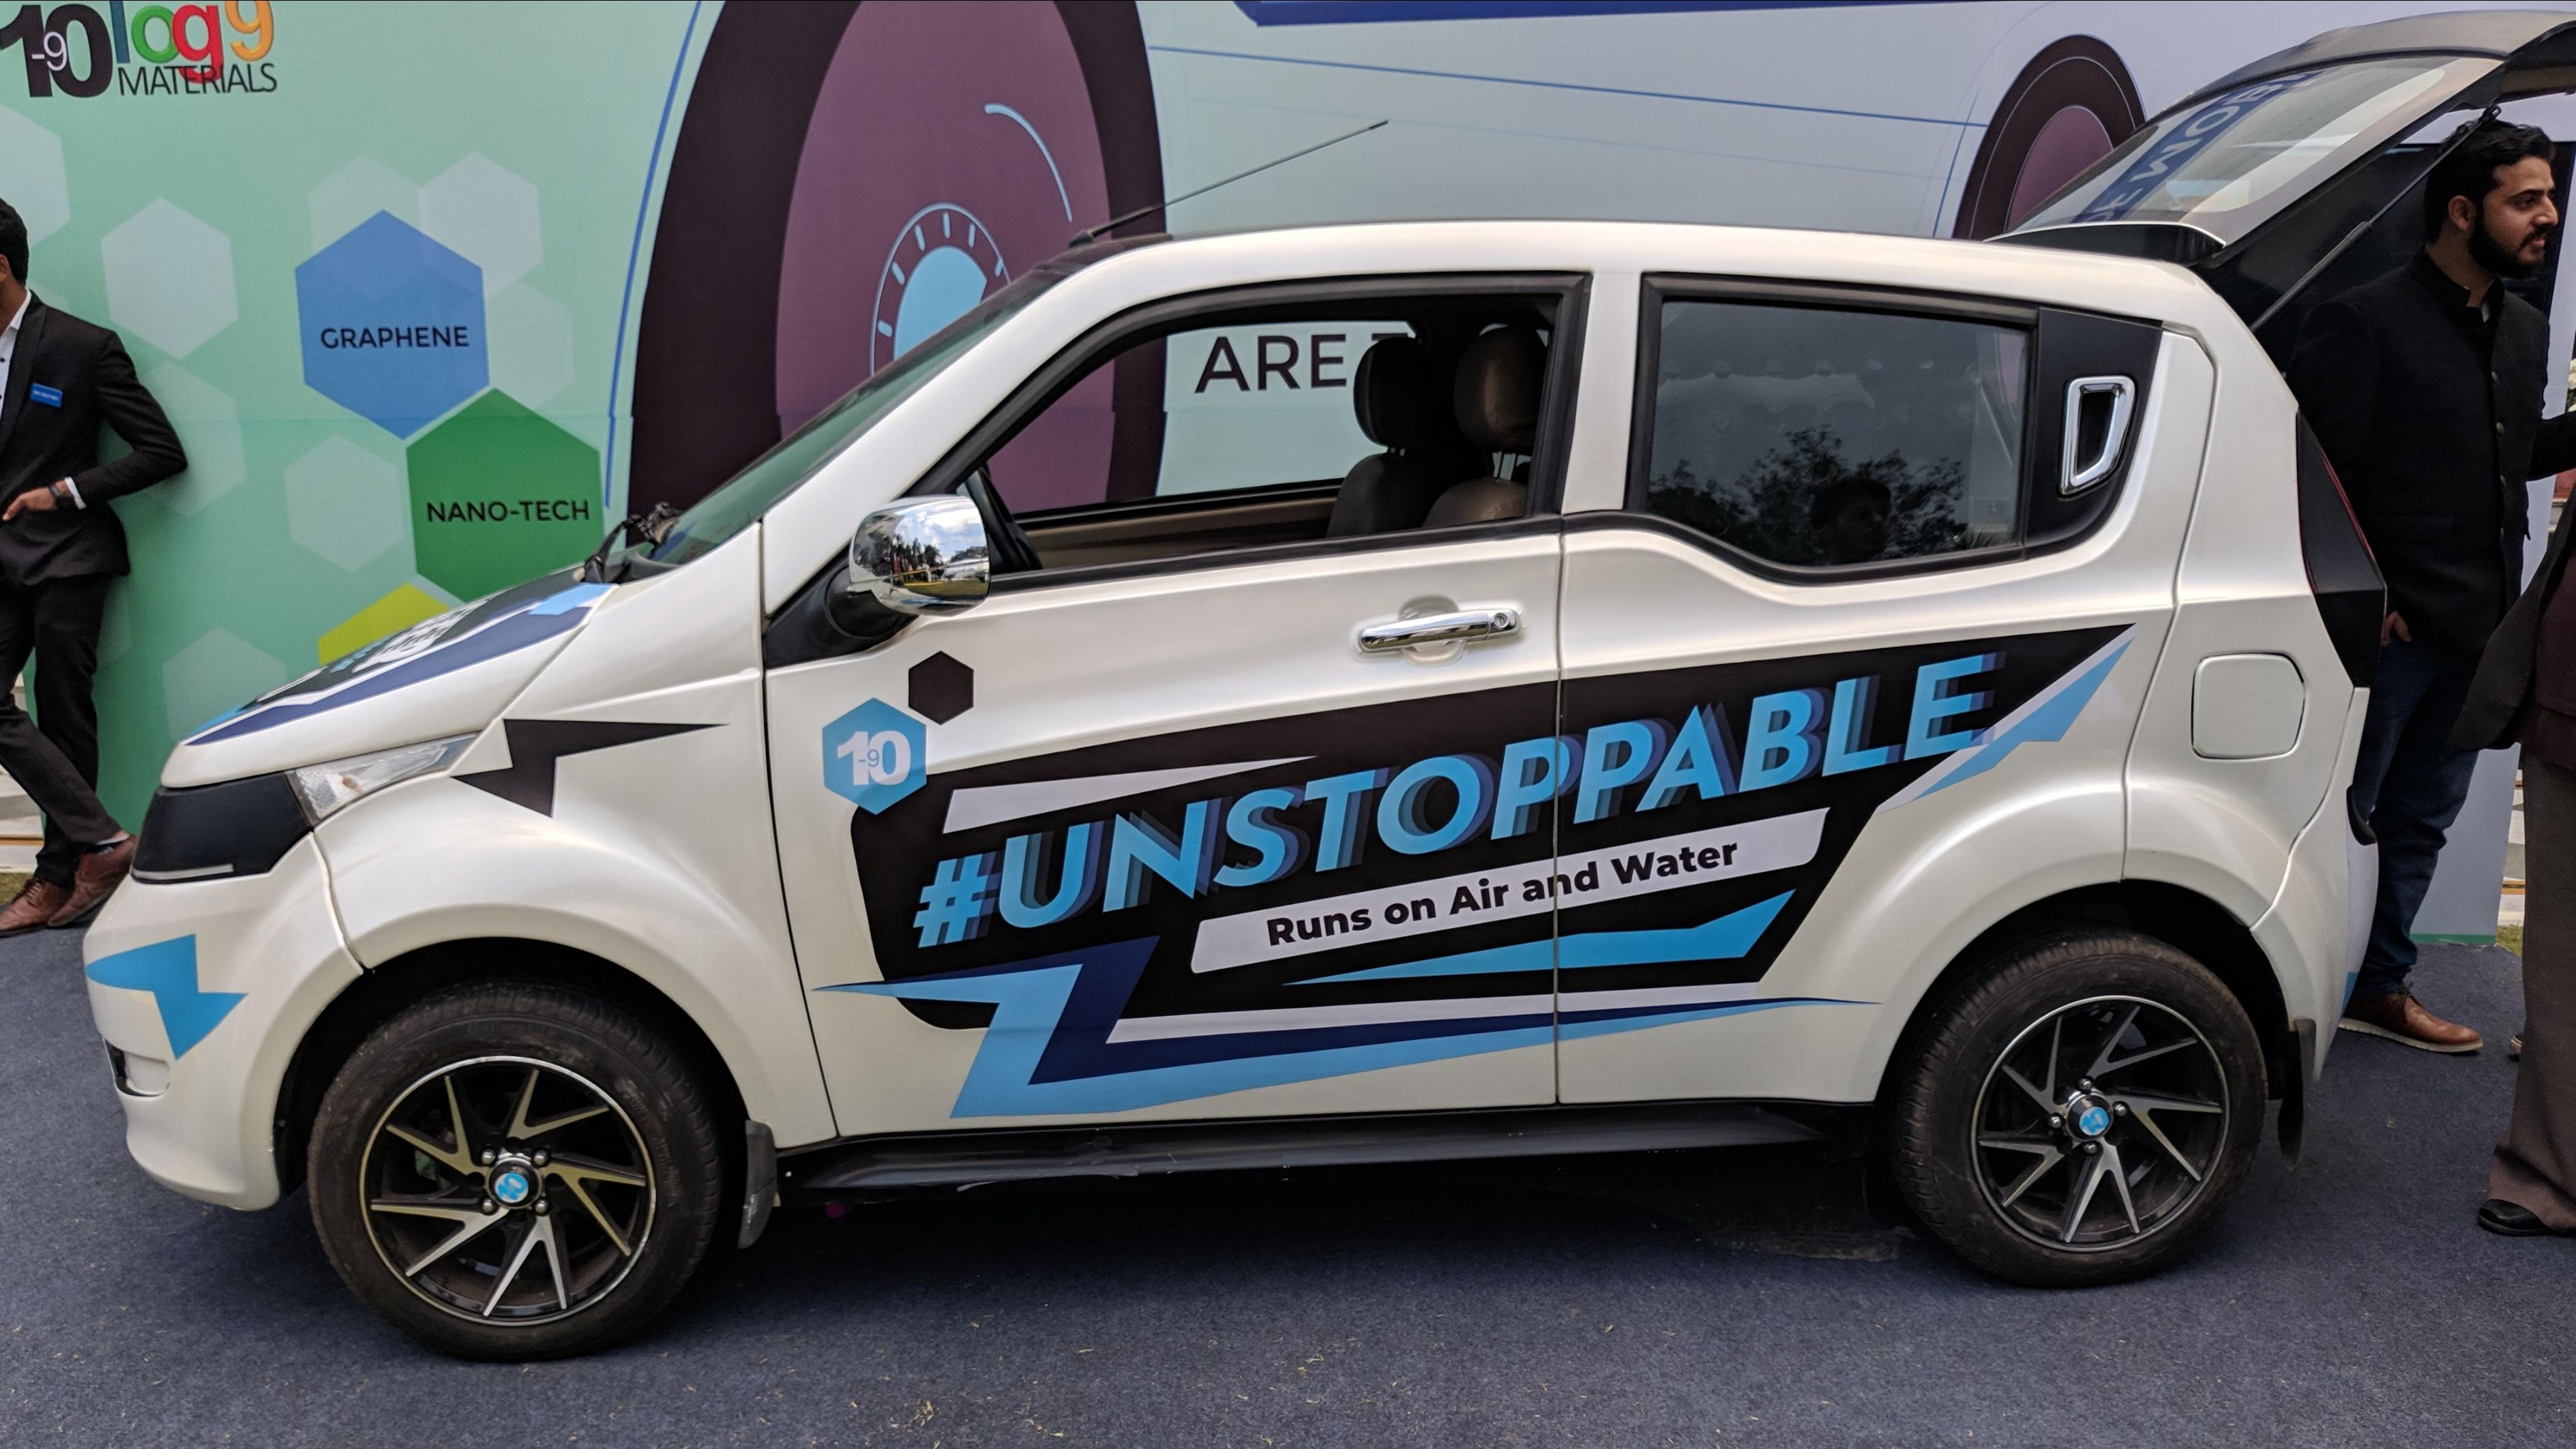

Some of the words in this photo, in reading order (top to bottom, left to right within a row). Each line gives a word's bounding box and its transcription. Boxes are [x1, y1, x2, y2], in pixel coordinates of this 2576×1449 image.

[118, 62, 278, 96] MATERIALS
[319, 324, 470, 350] GRAPHENE
[1194, 333, 1347, 394] ARE
[426, 499, 590, 523] NANO-TECH
[913, 652, 1995, 948] #UNSTOPPABLE
[1267, 906, 1372, 946] Runs
[1384, 897, 1436, 925] on
[1449, 878, 1509, 916] Air
[1522, 861, 1600, 902] and
[1611, 841, 1738, 885] Water
